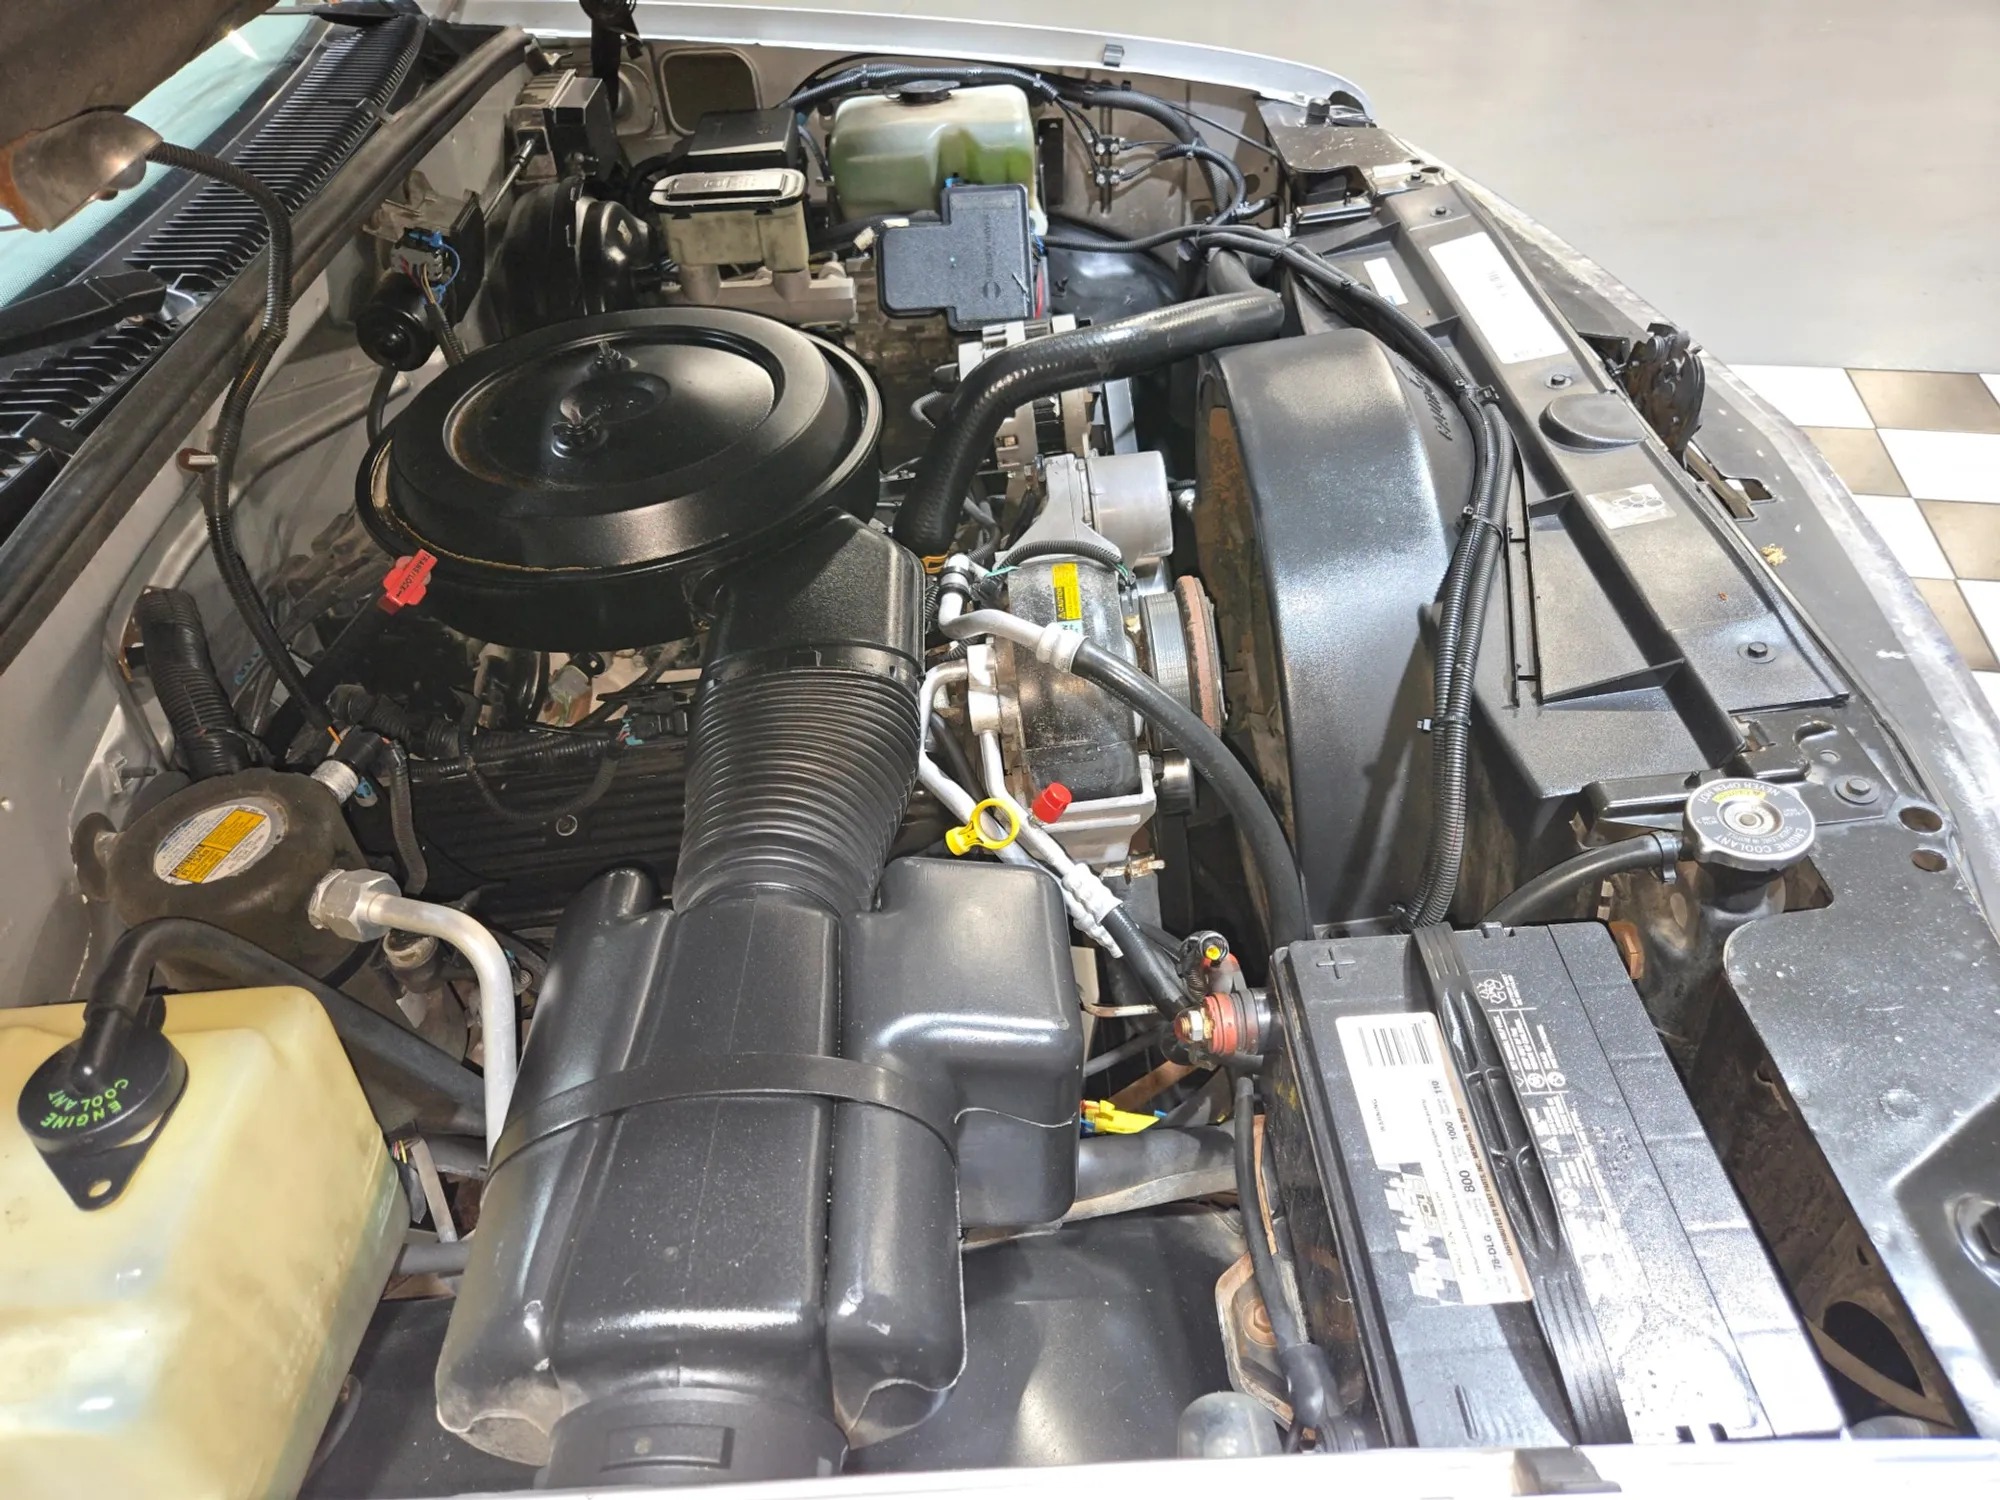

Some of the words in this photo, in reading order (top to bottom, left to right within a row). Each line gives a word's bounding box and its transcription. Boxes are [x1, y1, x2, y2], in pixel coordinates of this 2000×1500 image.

[1744, 782, 1780, 796] NEVER
[1713, 835, 1773, 854] COOLANT
[1776, 826, 1808, 852] ENGINE
[48, 1078, 129, 1112] COOLANT
[1431, 1079, 1442, 1093] 110
[40, 1100, 122, 1129] ENGINE
[1444, 1120, 1457, 1140] 1000
[1458, 1169, 1476, 1192] 800
[1486, 1192, 1496, 1207] BEST
[1494, 1218, 1512, 1255] DISTRIBUTED
[1483, 1234, 1501, 1269] 78-DLG
